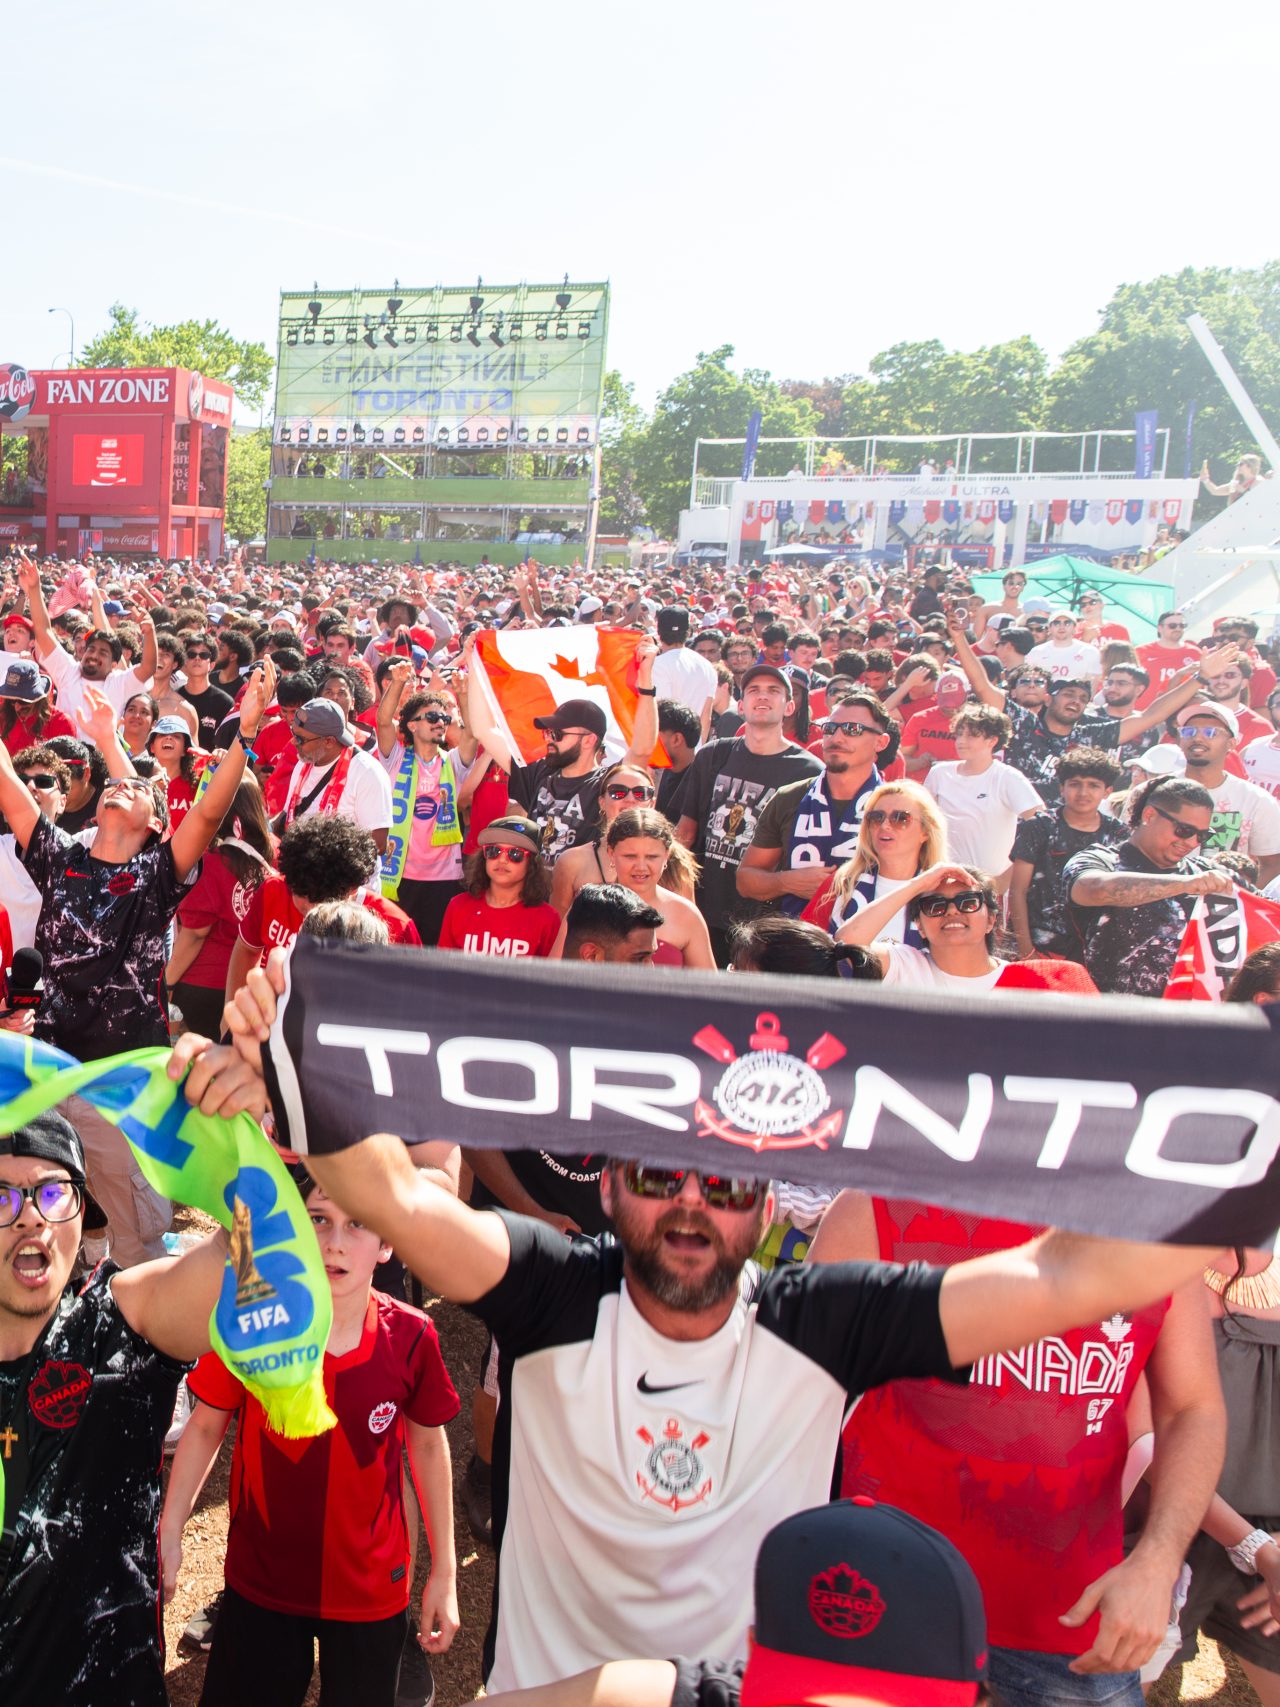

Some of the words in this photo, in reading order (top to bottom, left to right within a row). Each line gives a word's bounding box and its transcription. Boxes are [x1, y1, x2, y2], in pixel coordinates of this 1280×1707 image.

[47, 379, 95, 404] FAN
[99, 378, 169, 403] ZONE
[352, 389, 513, 411] TORONTO
[963, 486, 1011, 496] ULTRA
[120, 535, 150, 545] Coca-Cola
[1051, 666, 1069, 677] 20
[1159, 667, 1176, 682] 19
[920, 728, 957, 741] CANA
[12, 995, 42, 1004] TSN
[542, 1153, 569, 1177] FROM
[569, 1171, 601, 1182] COAST
[237, 1303, 291, 1334] FIFA
[34, 1378, 90, 1411] CANADA
[1086, 1398, 1114, 1421] 67
[813, 1592, 876, 1613] CANADA
